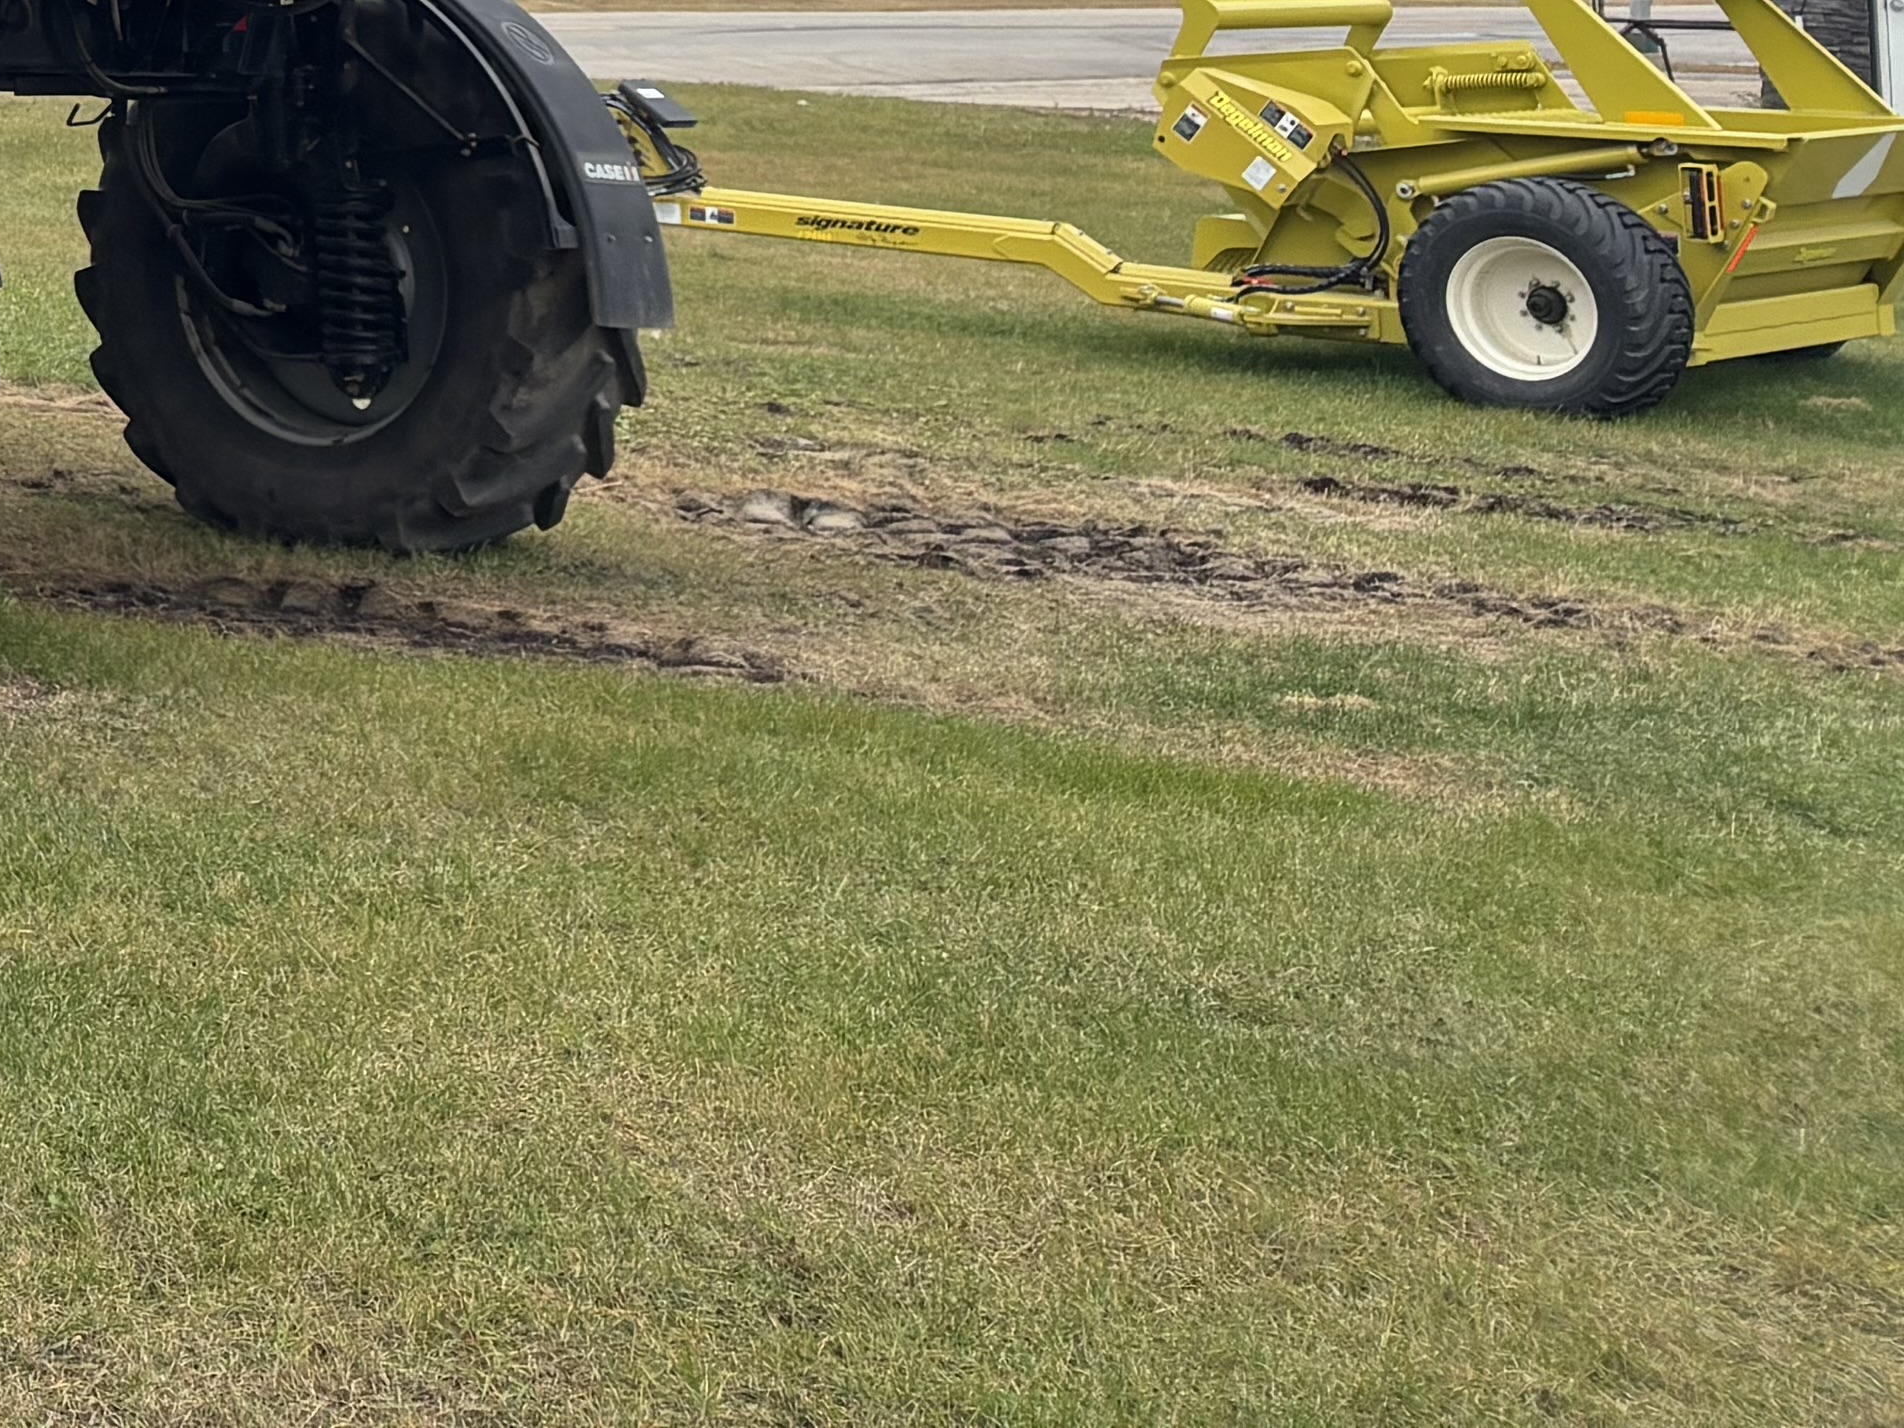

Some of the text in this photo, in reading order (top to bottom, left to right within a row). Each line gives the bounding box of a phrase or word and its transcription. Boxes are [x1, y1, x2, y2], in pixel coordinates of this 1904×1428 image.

[1208, 91, 1293, 162] Degelman
[584, 162, 625, 180] CASE
[795, 215, 920, 236] signature
